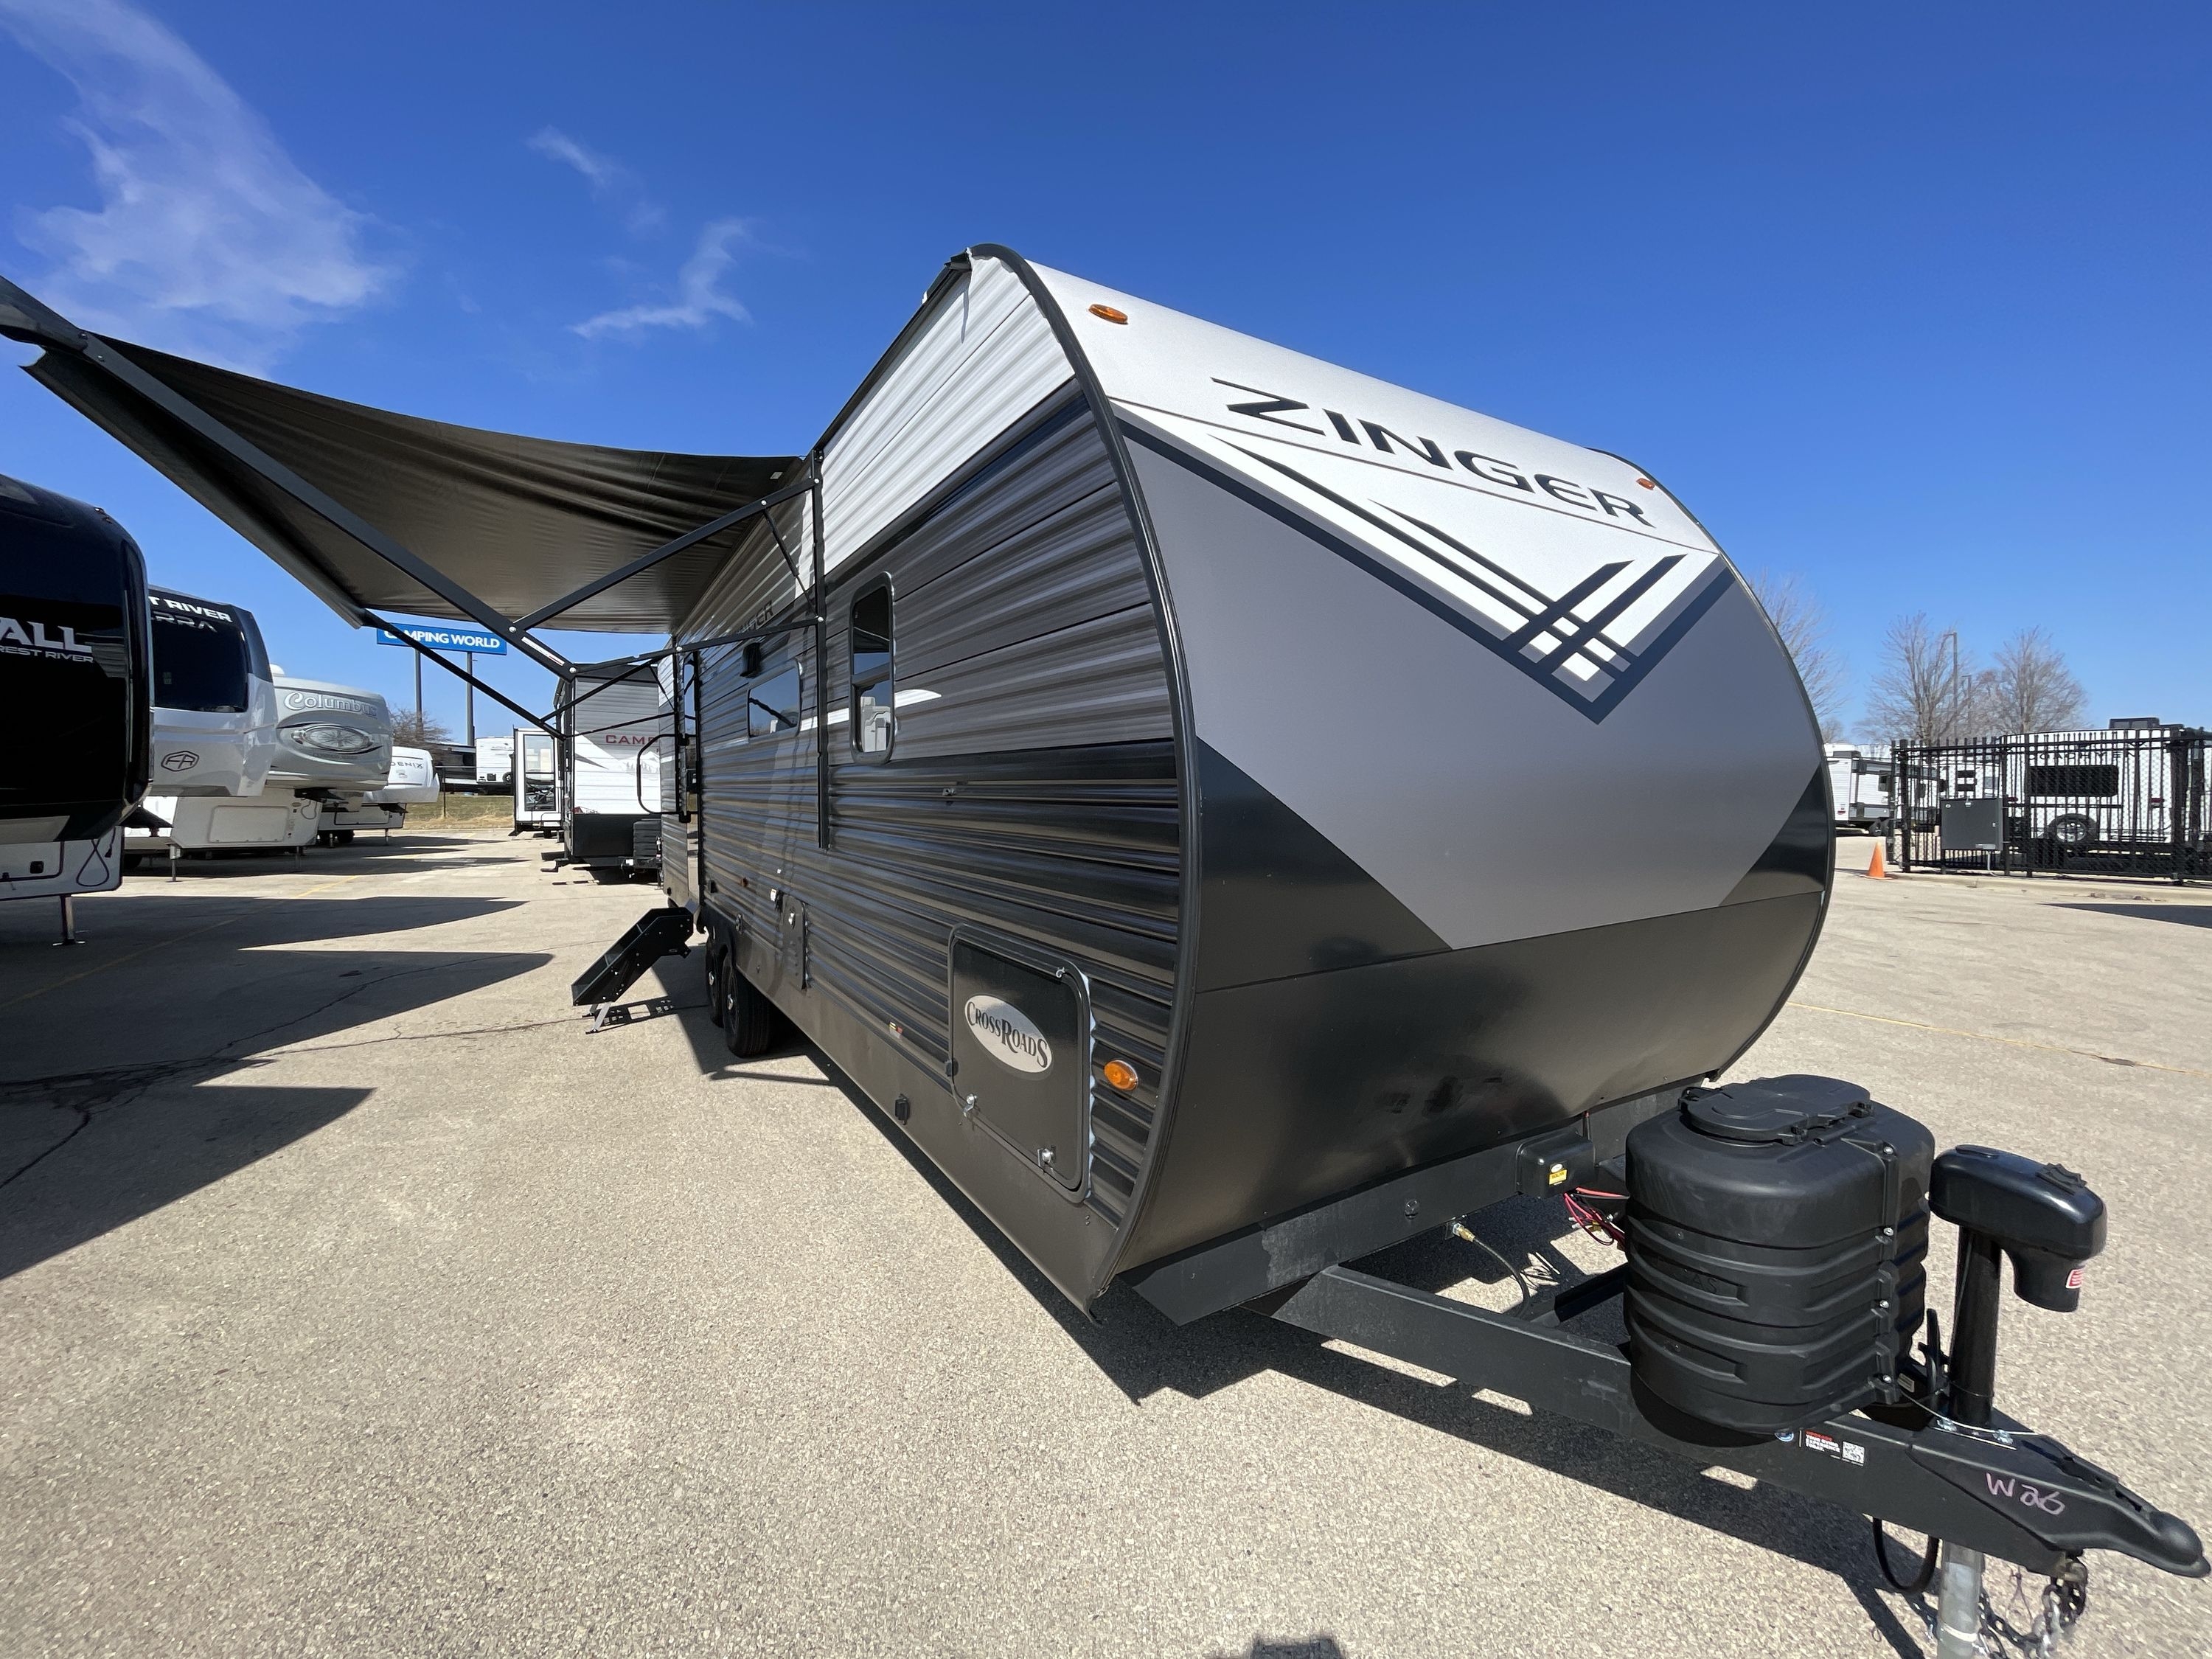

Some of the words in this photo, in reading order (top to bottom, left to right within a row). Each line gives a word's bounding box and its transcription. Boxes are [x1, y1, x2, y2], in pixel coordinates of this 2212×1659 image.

[1210, 377, 1656, 529] ZINGER
[163, 598, 233, 623] RIVER
[383, 629, 449, 644] CMPING
[451, 635, 501, 649] WORLD
[45, 650, 94, 663] RIVER
[283, 692, 378, 717] Columbus
